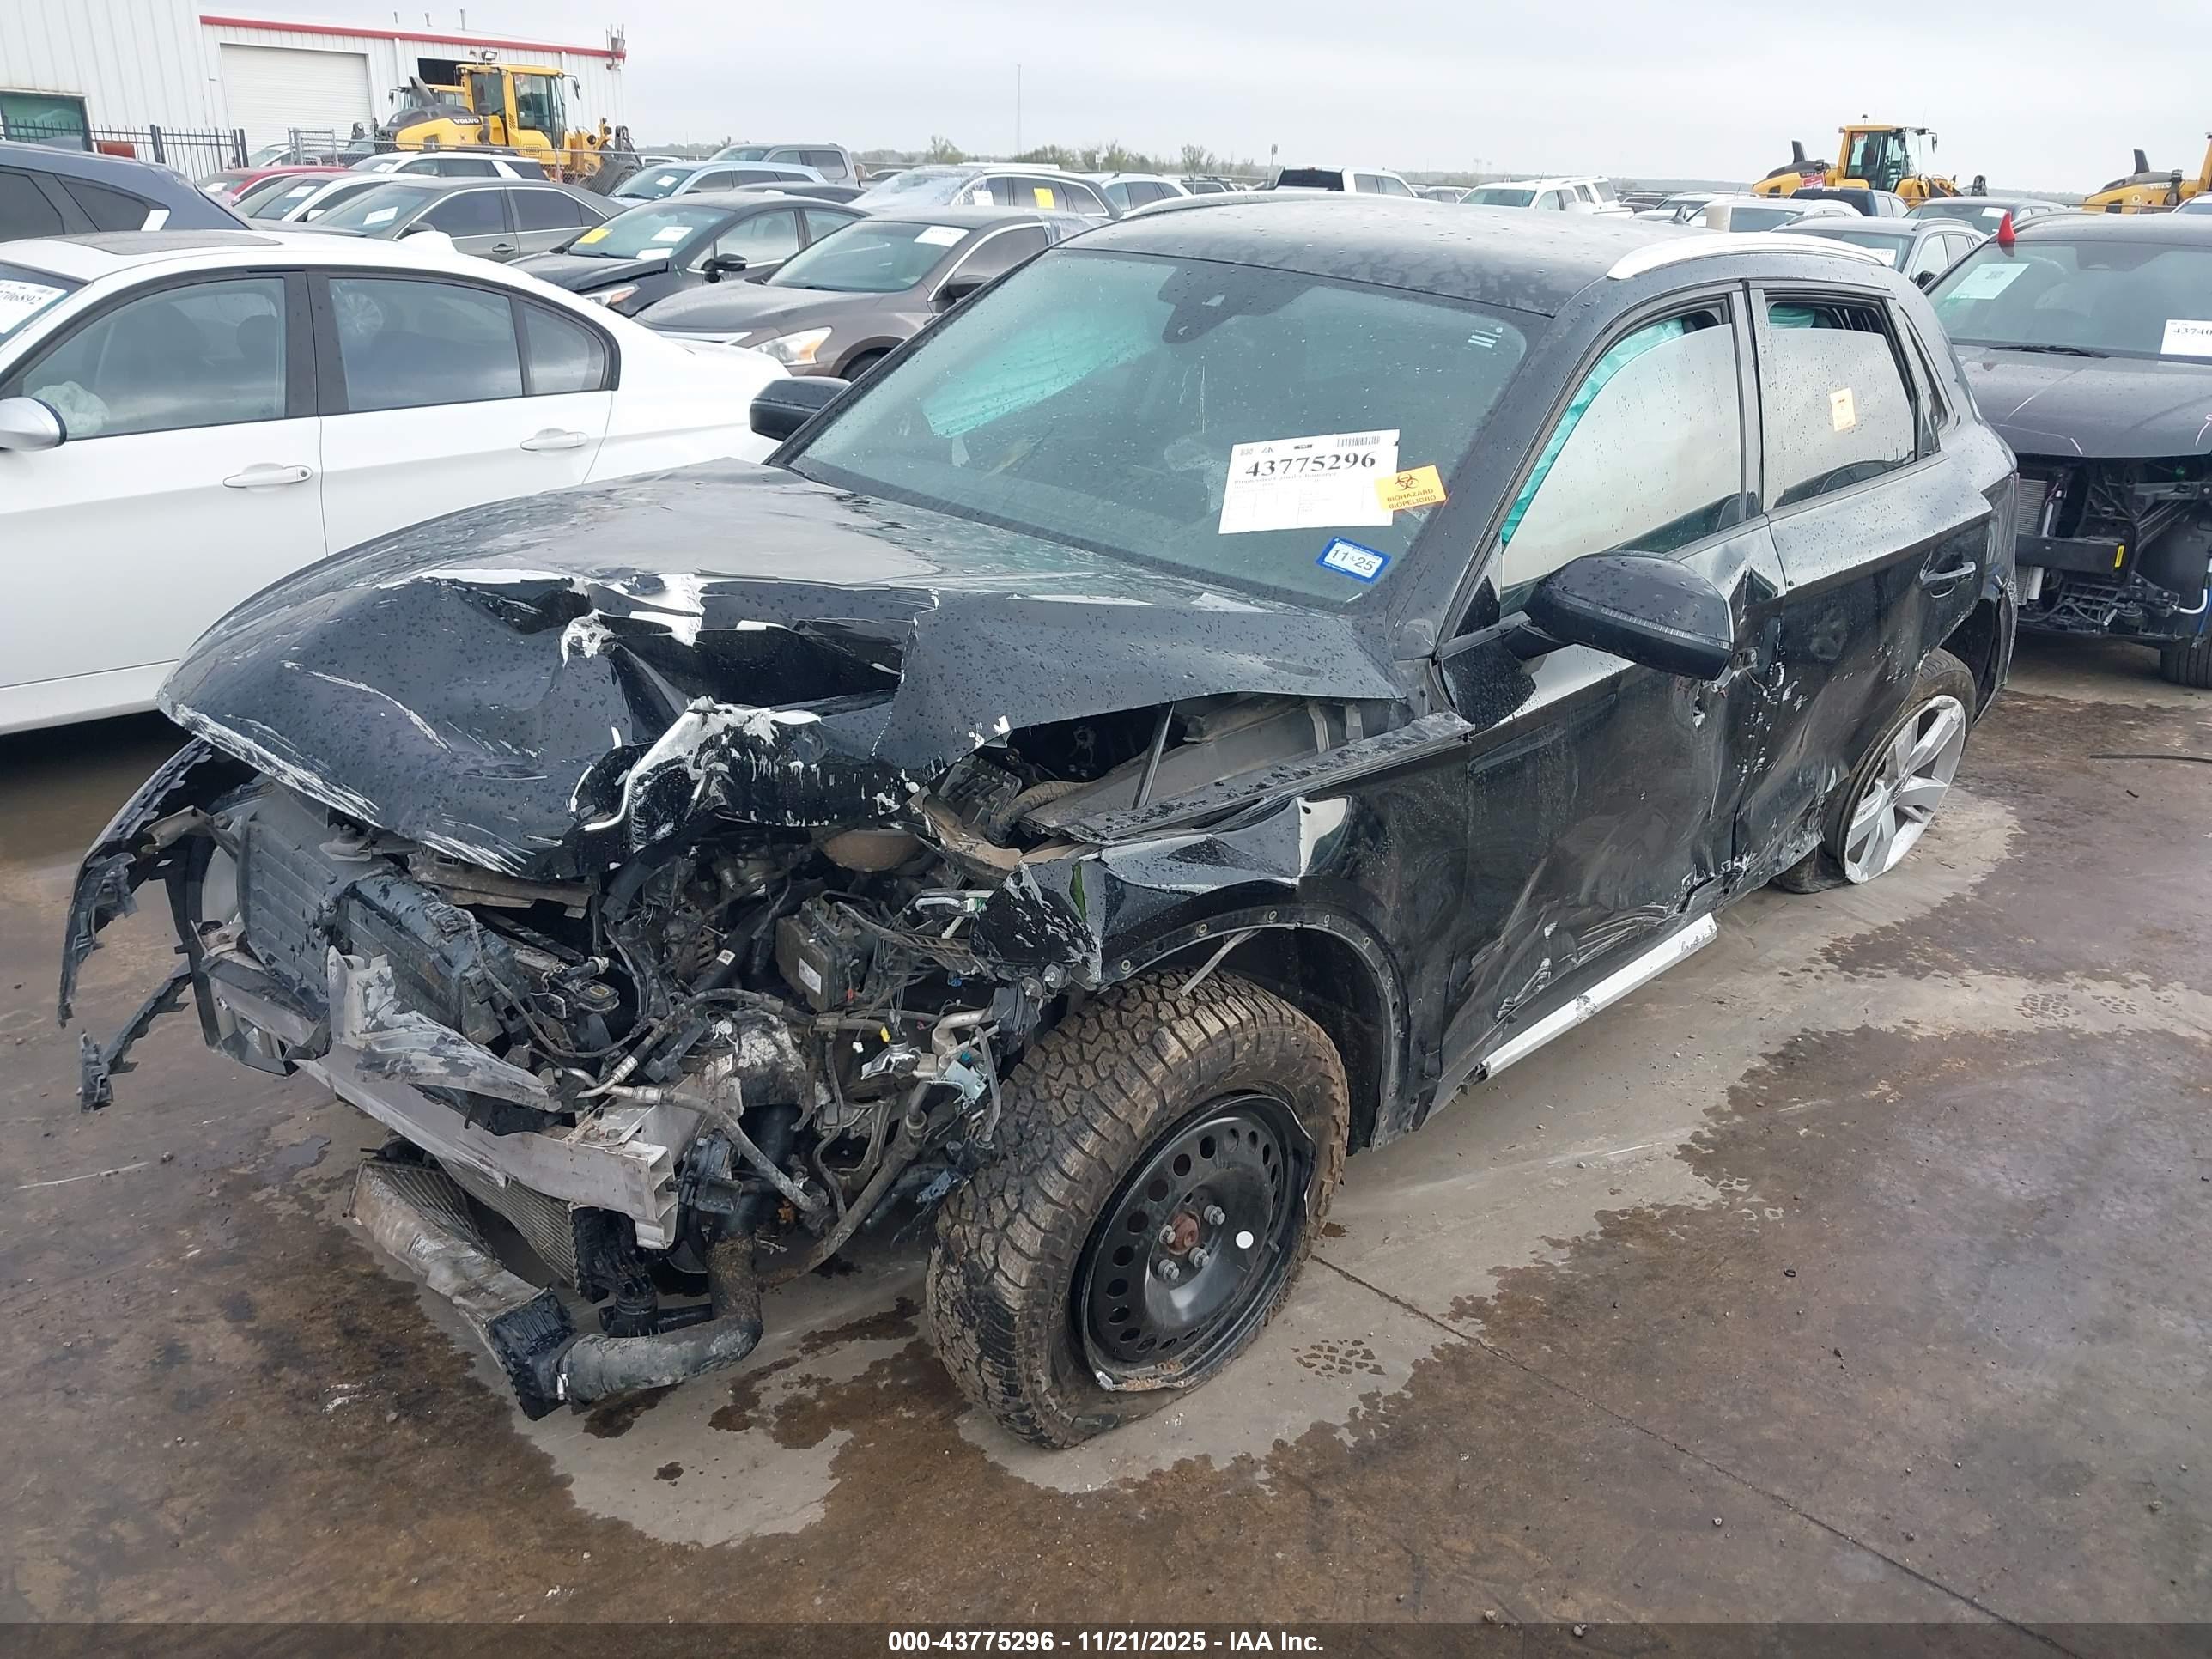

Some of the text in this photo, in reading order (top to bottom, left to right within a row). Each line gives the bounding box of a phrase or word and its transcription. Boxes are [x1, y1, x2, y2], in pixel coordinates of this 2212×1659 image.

[1245, 451, 1376, 477] 43775296
[1387, 488, 1434, 502] BIOHAZARD
[1389, 495, 1437, 509] BIOPELIGRO
